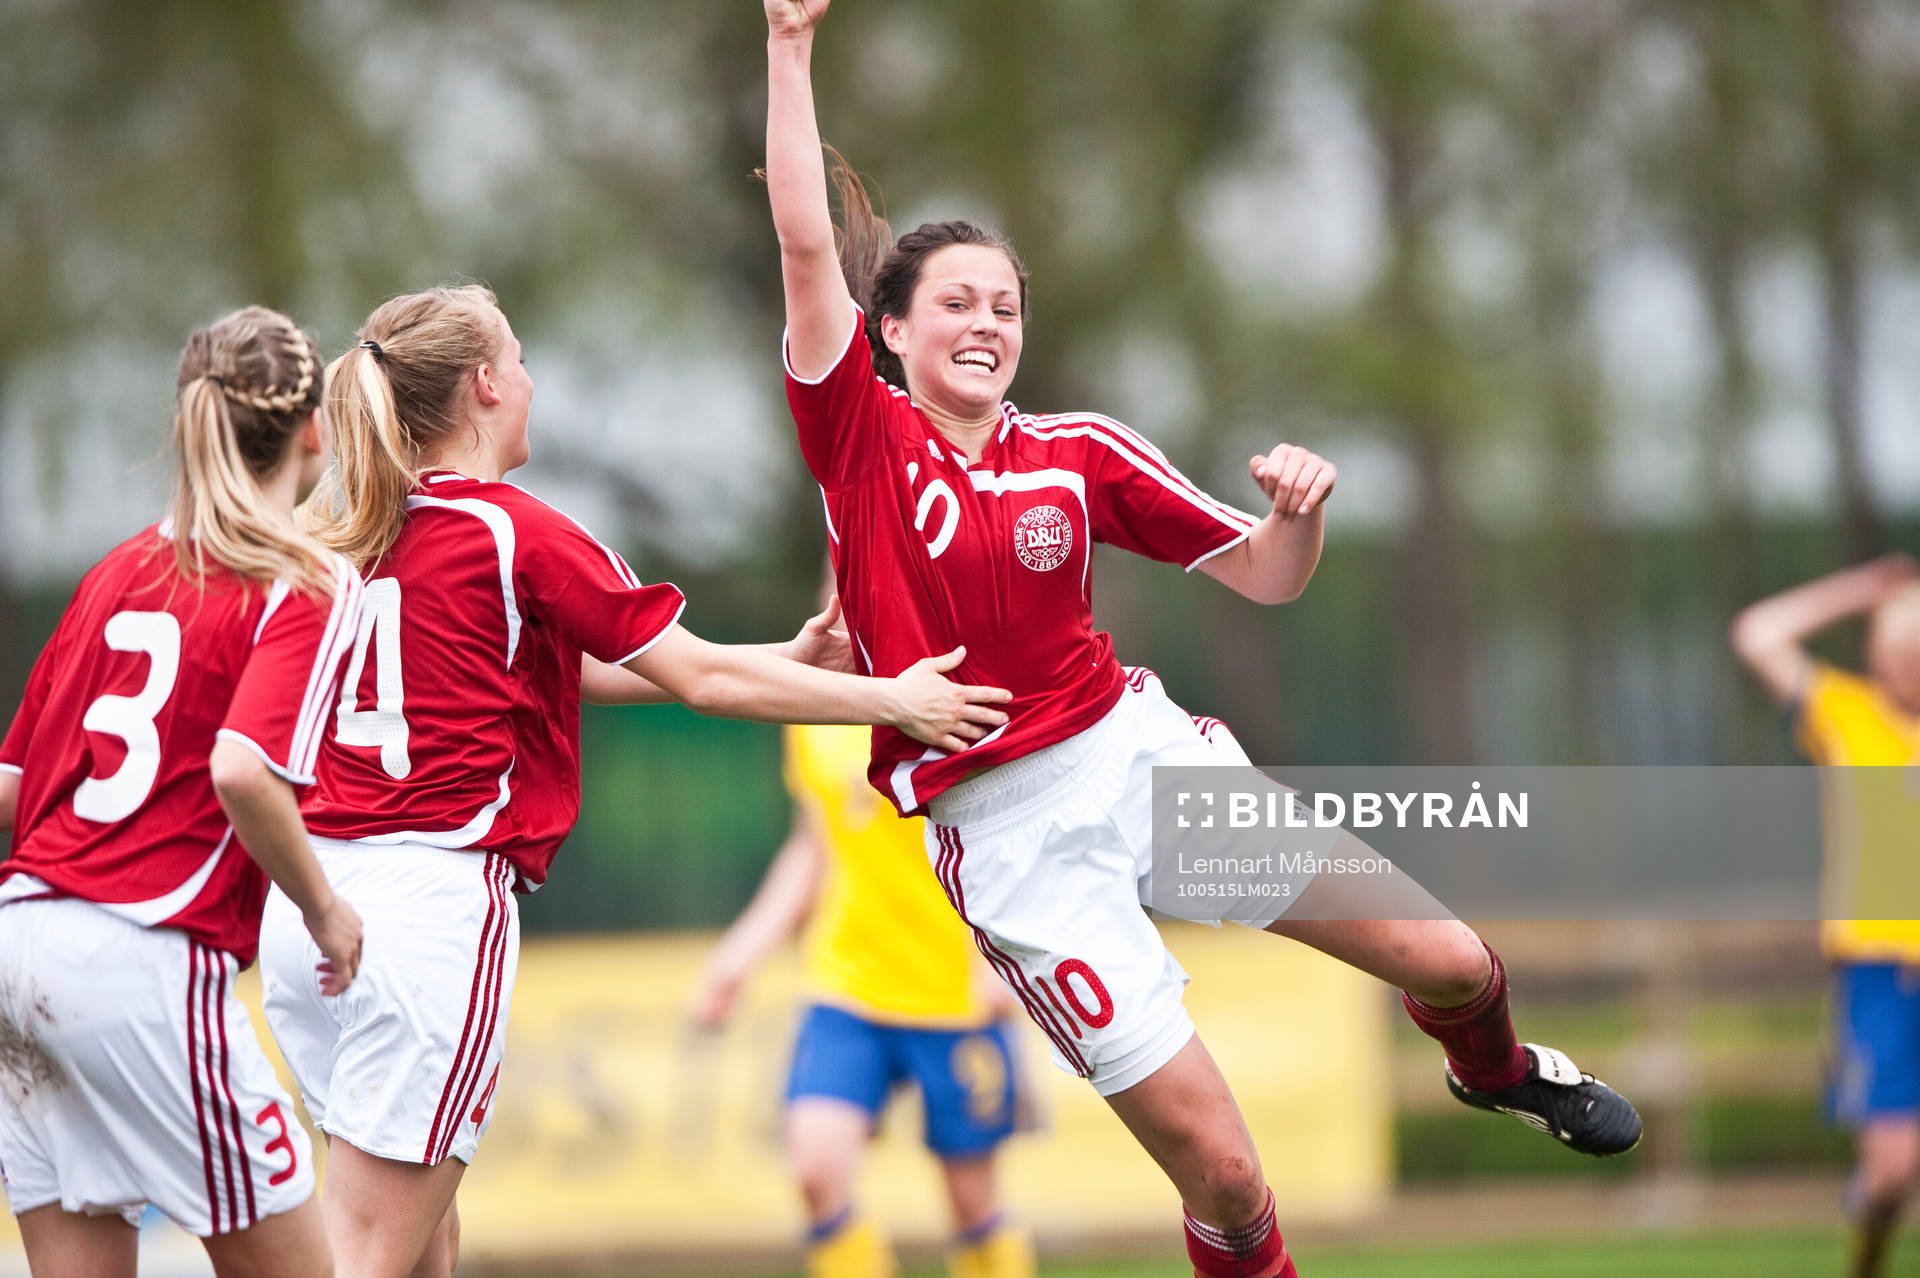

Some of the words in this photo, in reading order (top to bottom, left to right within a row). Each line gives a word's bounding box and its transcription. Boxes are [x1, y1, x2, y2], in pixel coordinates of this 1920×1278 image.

[1015, 526, 1032, 564] DANSK
[1060, 522, 1071, 558] UNION
[1026, 526, 1062, 548] DBU
[1034, 559, 1058, 569] 1889
[73, 610, 181, 824] 3
[335, 577, 411, 780] 4
[1035, 958, 1114, 1040] 10
[255, 1101, 297, 1186] 3
